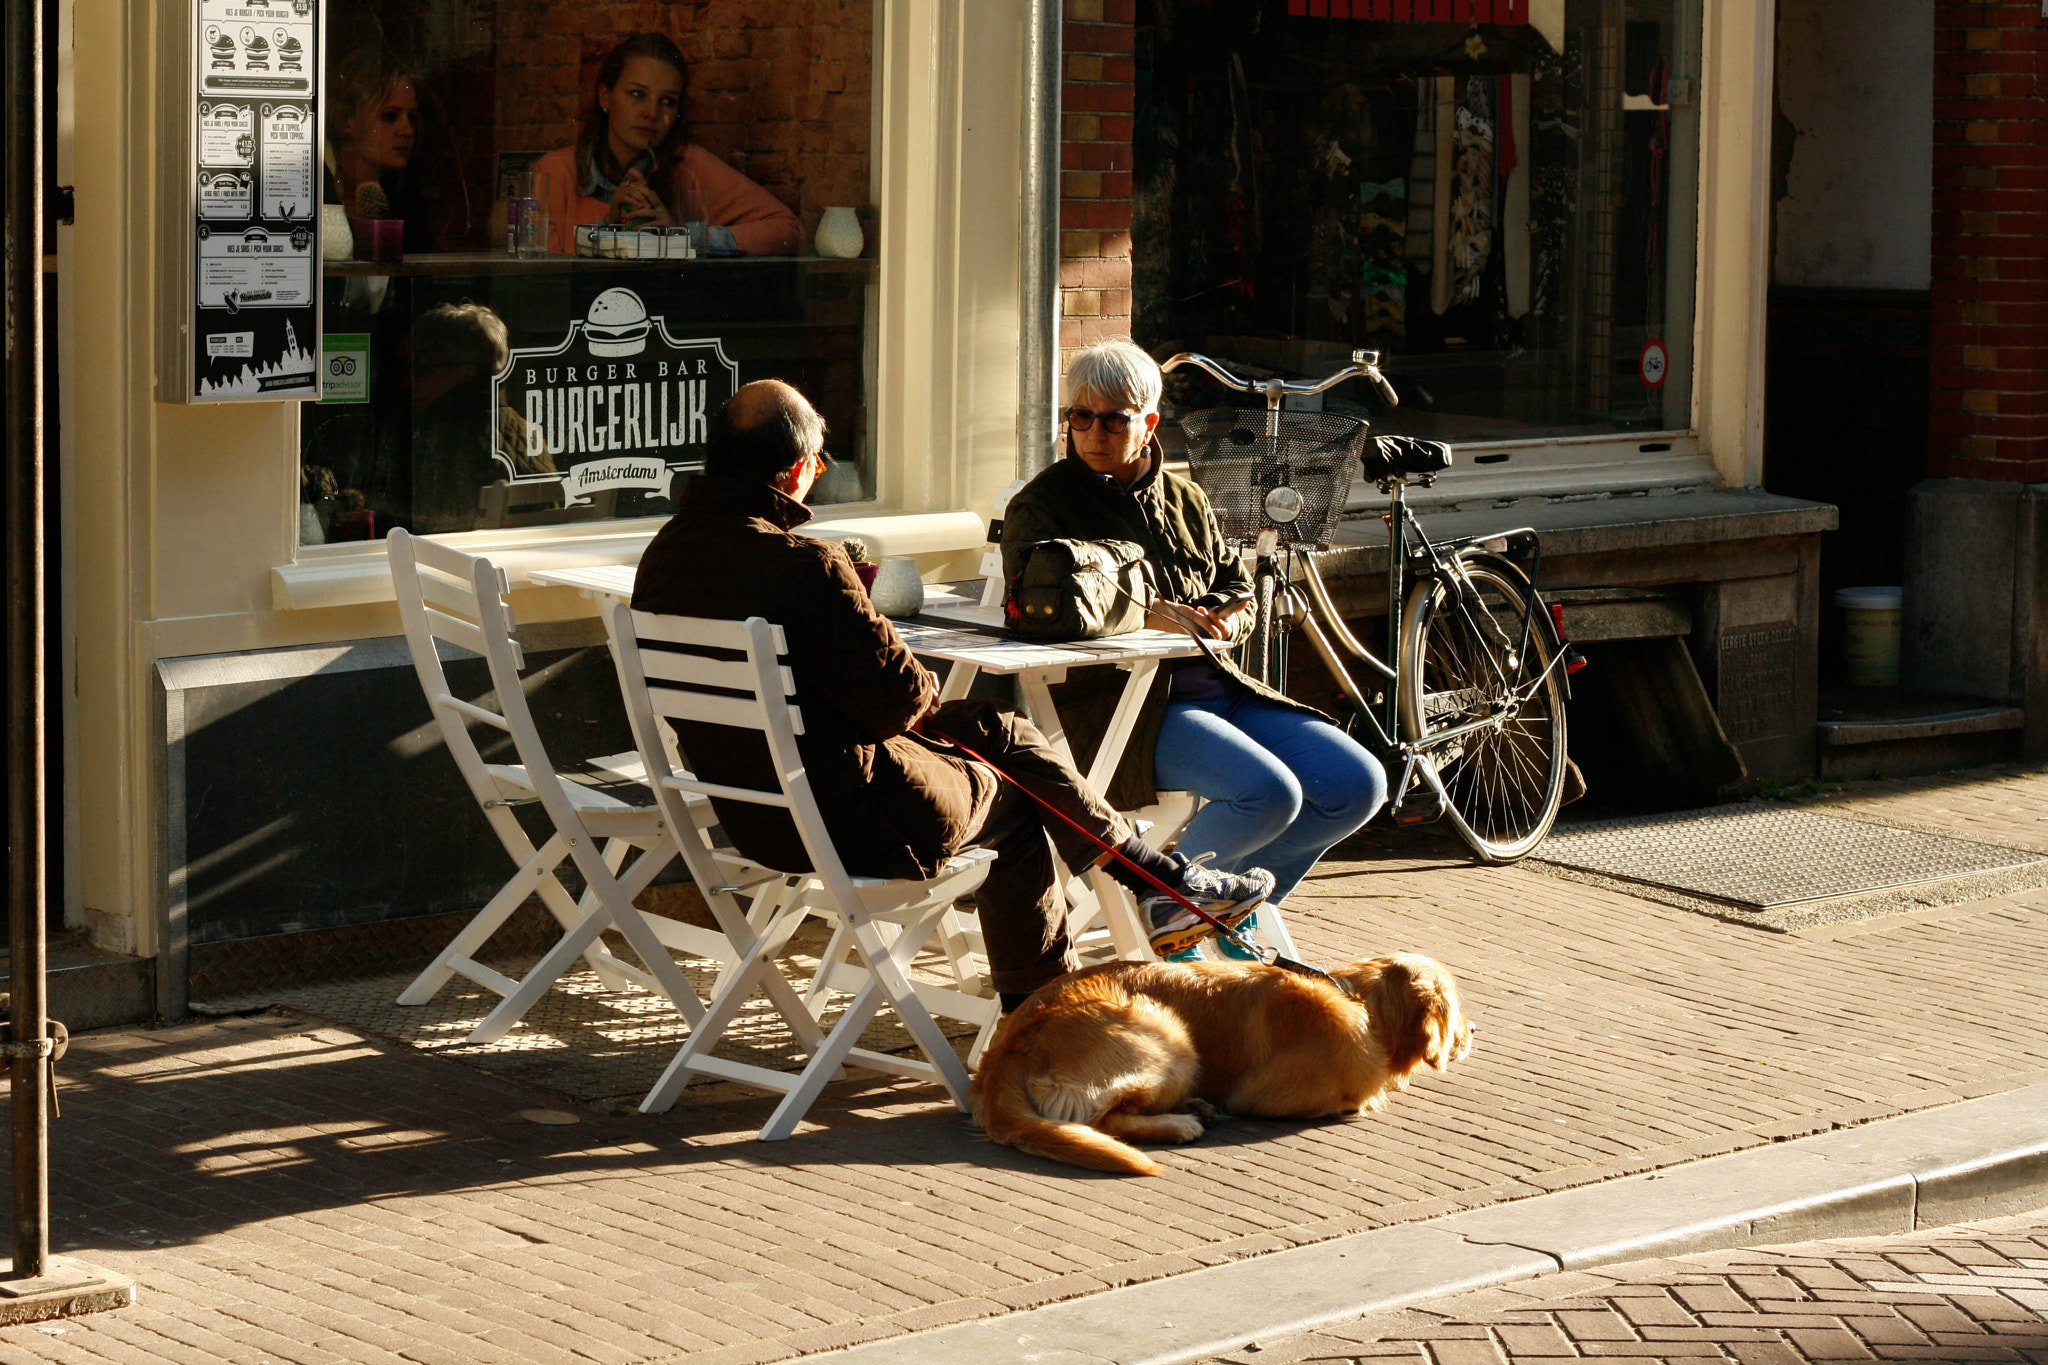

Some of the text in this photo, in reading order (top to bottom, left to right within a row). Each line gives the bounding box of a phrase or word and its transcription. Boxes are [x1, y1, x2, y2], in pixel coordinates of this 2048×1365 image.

[526, 360, 708, 385] BURGER BAR
[323, 380, 361, 390] tripadvisor
[526, 379, 707, 457] BURGERLIJK
[578, 463, 658, 487] Amsterdams
